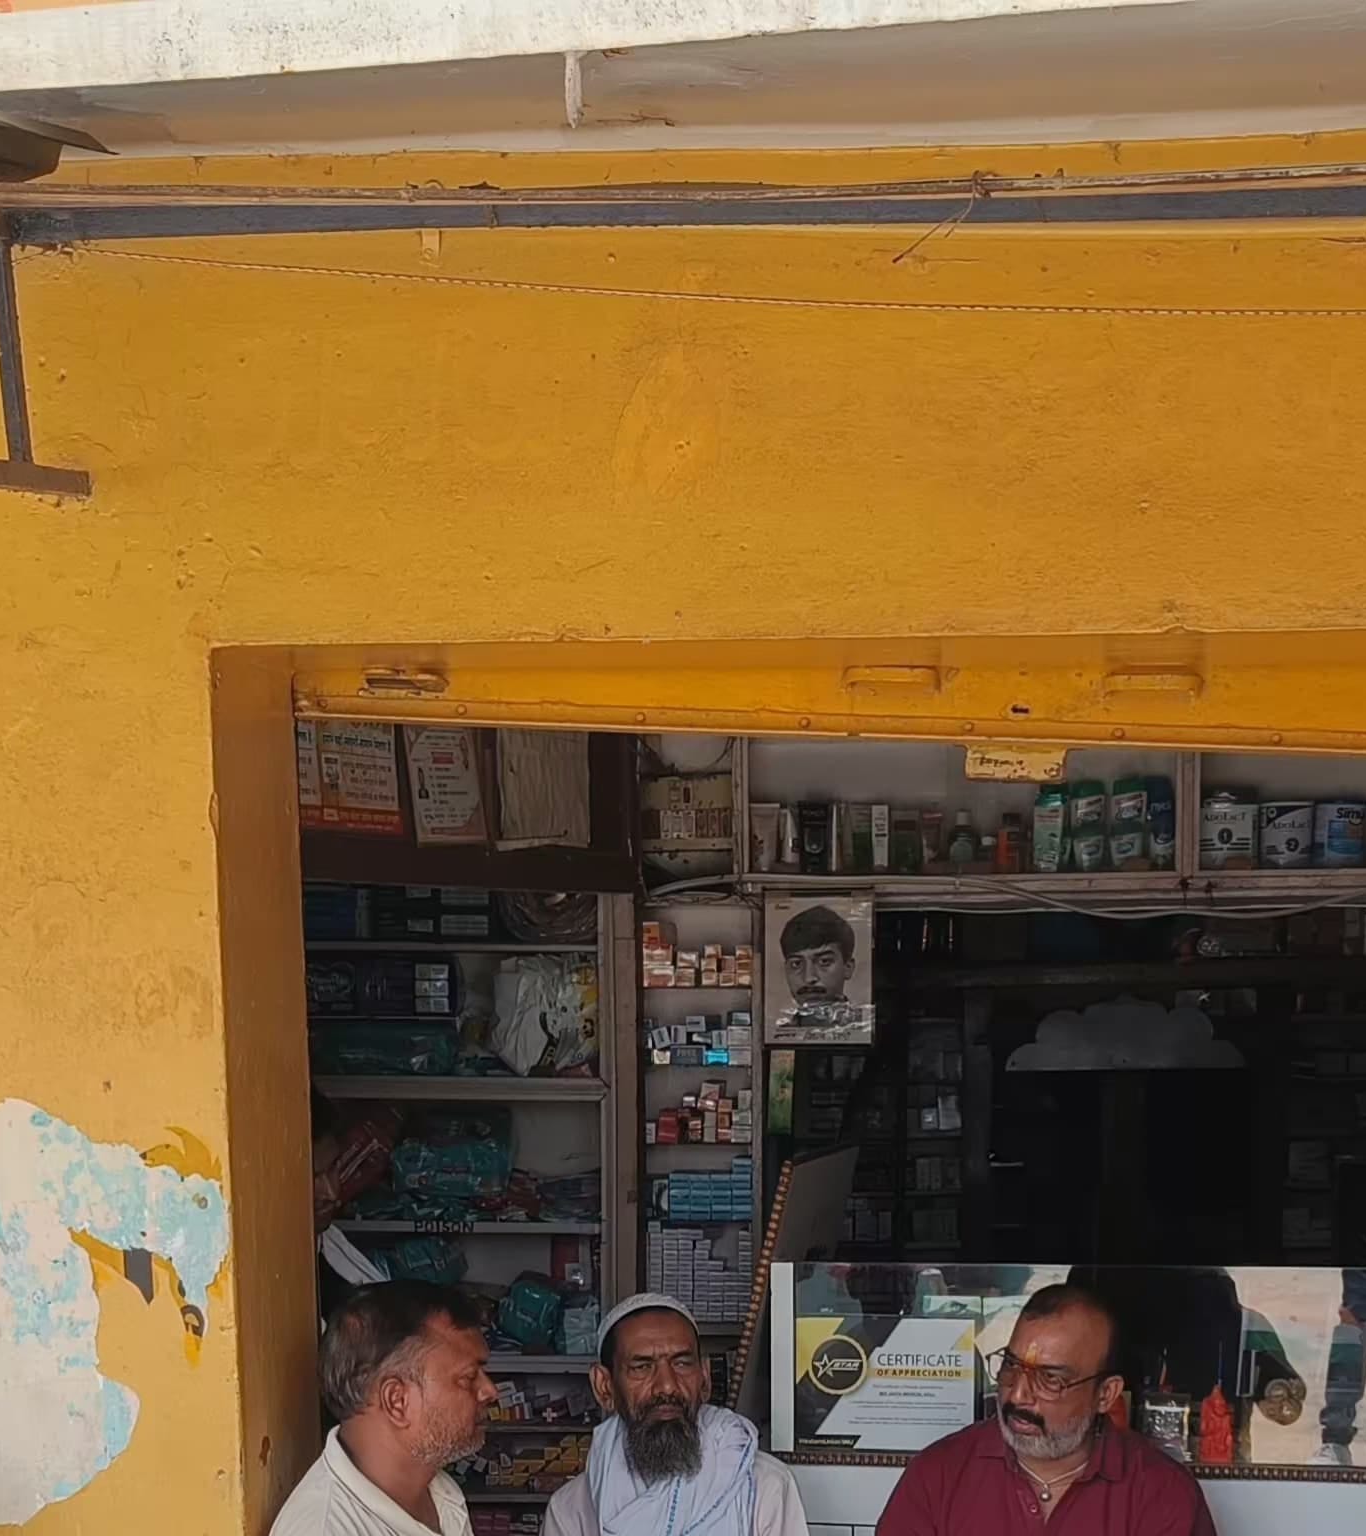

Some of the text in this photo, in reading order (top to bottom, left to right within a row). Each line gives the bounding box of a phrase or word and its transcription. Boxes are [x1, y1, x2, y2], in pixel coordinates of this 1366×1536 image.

[414, 1219, 474, 1235] POISON
[877, 1353, 963, 1367] CERTIFICATE
[877, 1369, 962, 1377] OF APPRECIATION
